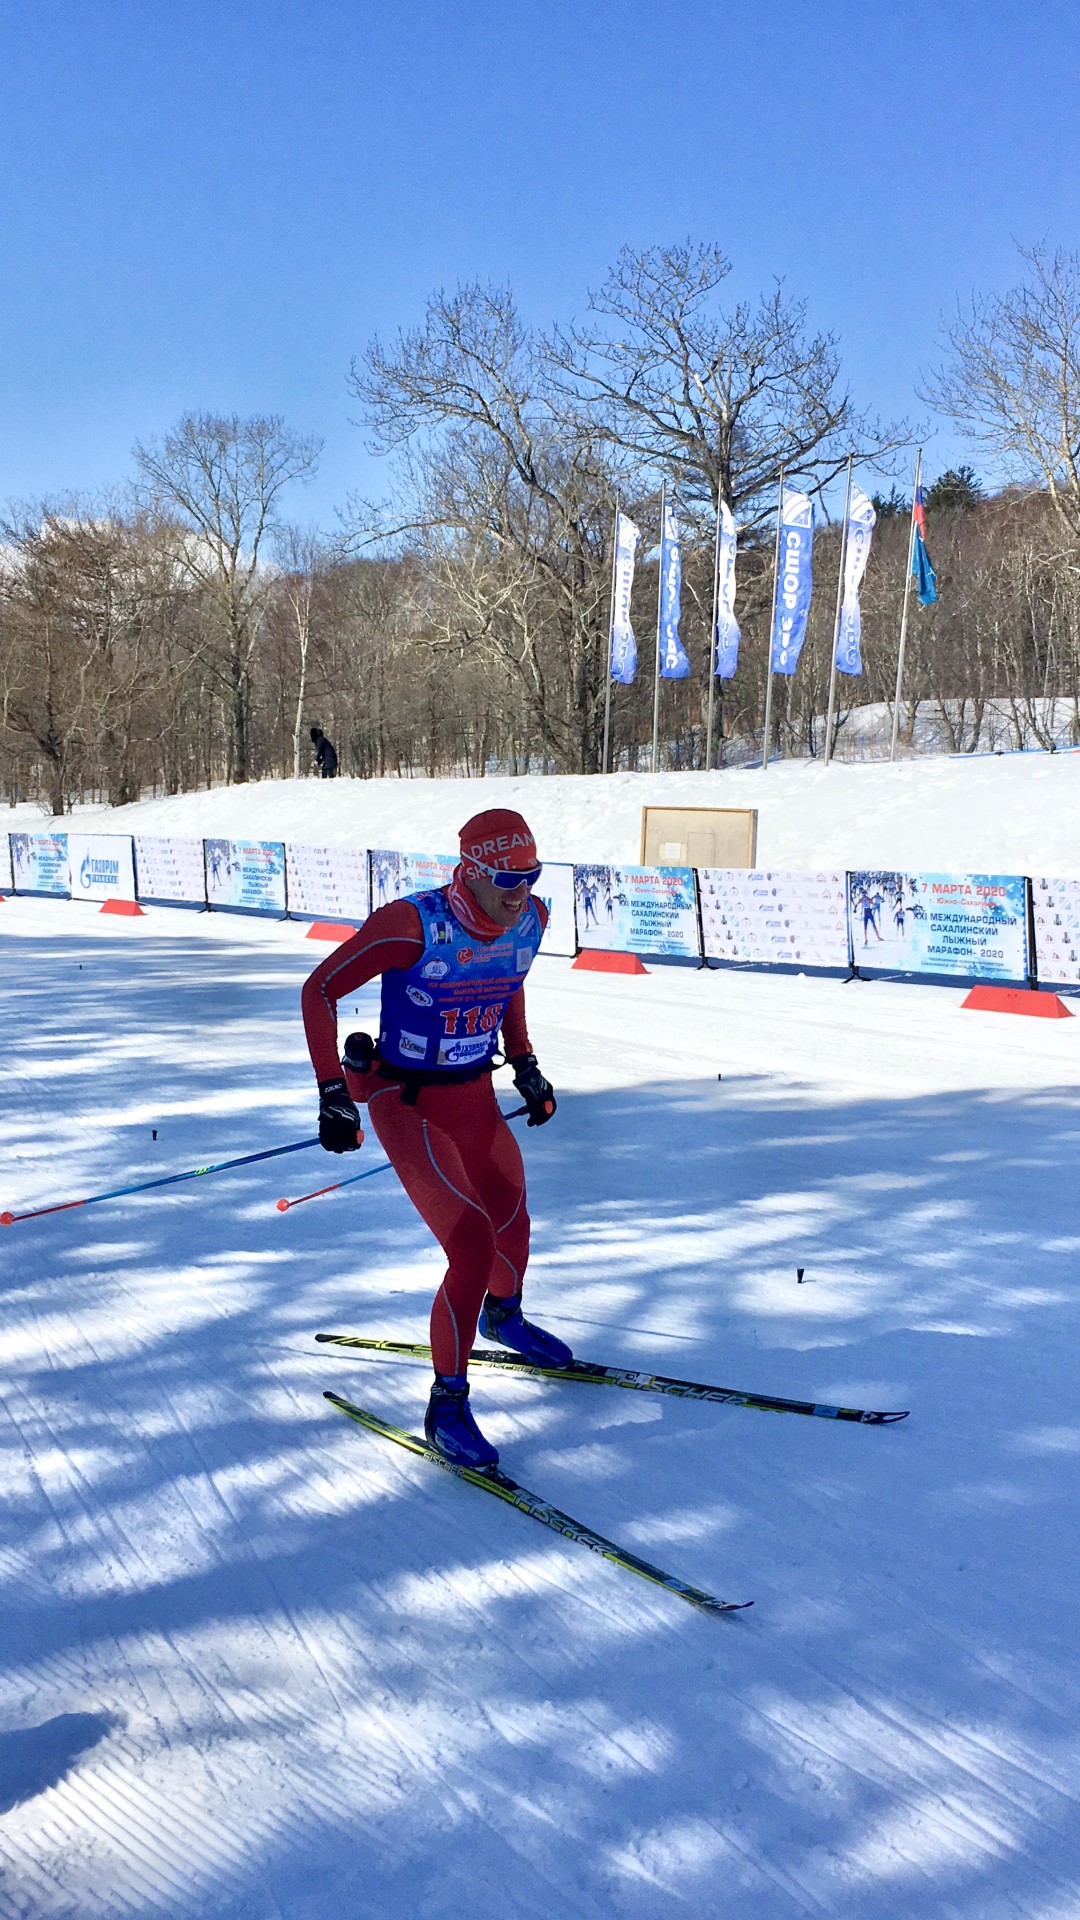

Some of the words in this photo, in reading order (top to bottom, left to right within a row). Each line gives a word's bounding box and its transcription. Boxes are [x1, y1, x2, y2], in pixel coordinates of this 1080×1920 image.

[782, 530, 801, 609] СШОР
[470, 833, 536, 859] DREAM
[466, 862, 489, 880] SK
[624, 875, 629, 883] 7
[631, 875, 660, 885] МАРТА
[662, 876, 683, 886] 2020
[921, 883, 928, 893] 7
[932, 883, 972, 895] МАРТА
[976, 885, 1006, 897] 2020
[631, 900, 692, 910] МЕЖДУНАРОДНЫЙ
[631, 910, 680, 919] САХАЛИНСКИЙ
[930, 912, 1017, 926] МЕЖДУНАРОДНЫЙ
[640, 919, 672, 928] ЛЫЖНЫЙ
[930, 924, 999, 935] САХАЛИНСКИЙ
[942, 935, 987, 946] ЛЫЖНЫЙ
[980, 949, 1004, 959] 2020
[423, 1451, 465, 1478] FISCHER
